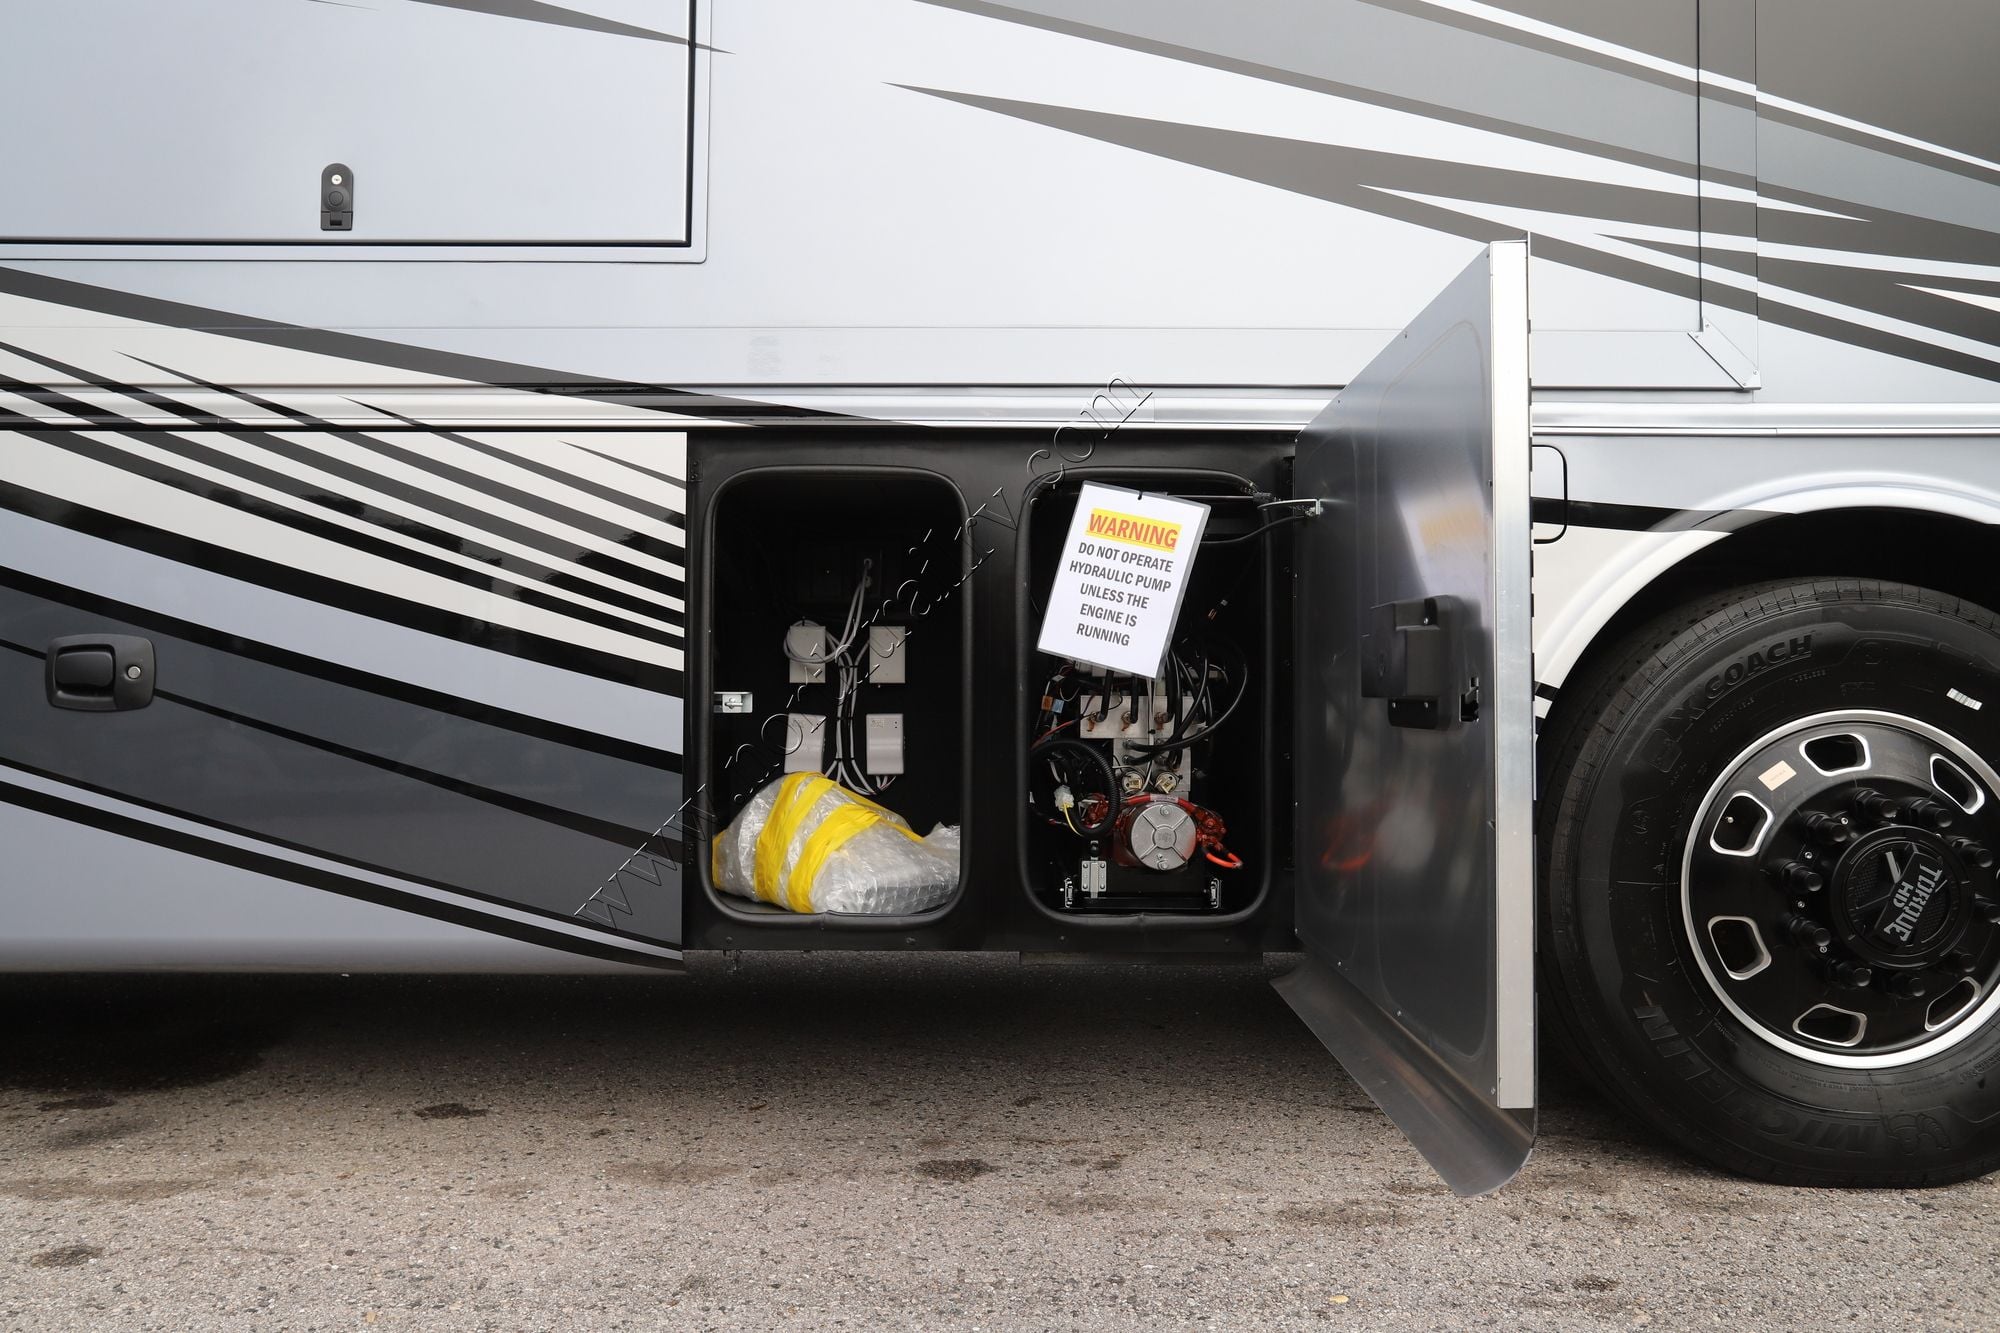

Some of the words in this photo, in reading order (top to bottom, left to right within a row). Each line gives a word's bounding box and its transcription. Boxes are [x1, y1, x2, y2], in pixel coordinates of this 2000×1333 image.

[1089, 514, 1178, 548] WARNING
[1079, 542, 1094, 556] DO
[1096, 545, 1120, 560] NOT
[1121, 551, 1173, 573] OPERATE
[1069, 560, 1133, 584] HYDRAULIC
[1135, 575, 1172, 593] PUMP
[1080, 583, 1124, 603] UNLESS
[1127, 593, 1150, 609] THE
[1080, 603, 1123, 624] ENGINE
[1125, 614, 1138, 627] IS
[1076, 623, 1130, 646] RUNNING
[1705, 634, 1812, 699] COACH
[1884, 863, 1943, 942] TORQUE
[1893, 881, 1914, 908] HD
